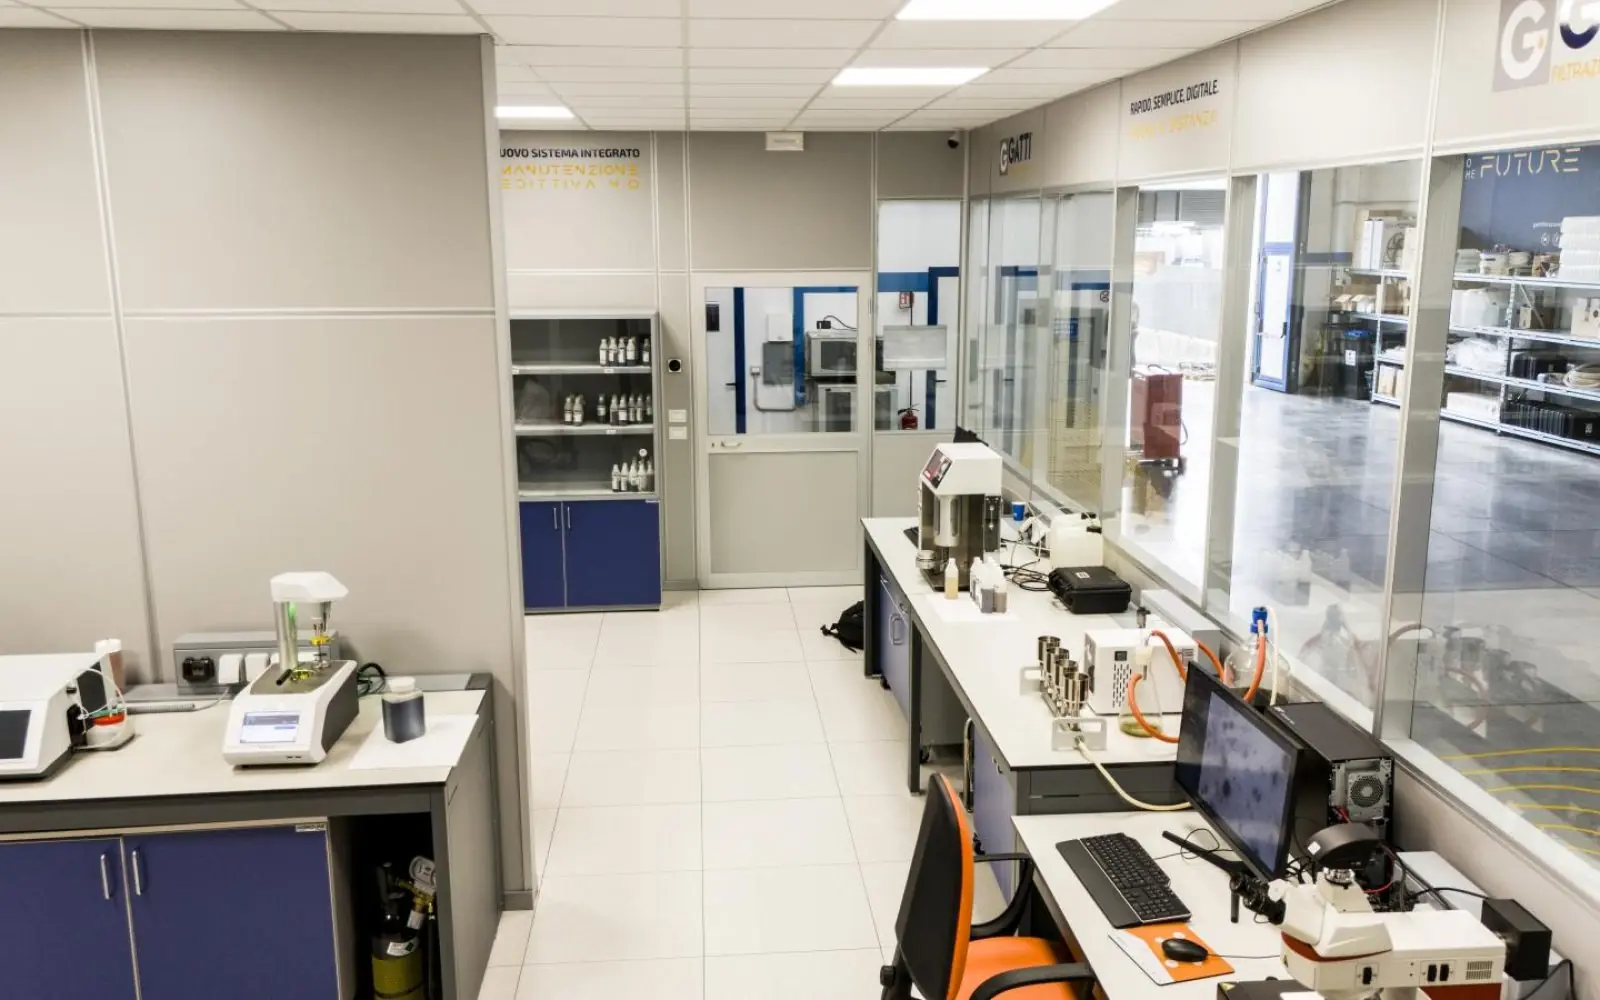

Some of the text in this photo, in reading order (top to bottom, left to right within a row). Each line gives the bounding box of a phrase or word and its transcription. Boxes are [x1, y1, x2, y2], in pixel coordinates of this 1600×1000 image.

[531, 148, 579, 158] SISTEMA
[580, 148, 640, 158] INTEGRATO
[1008, 131, 1033, 164] GATTI
[1480, 148, 1581, 178] FUTURE
